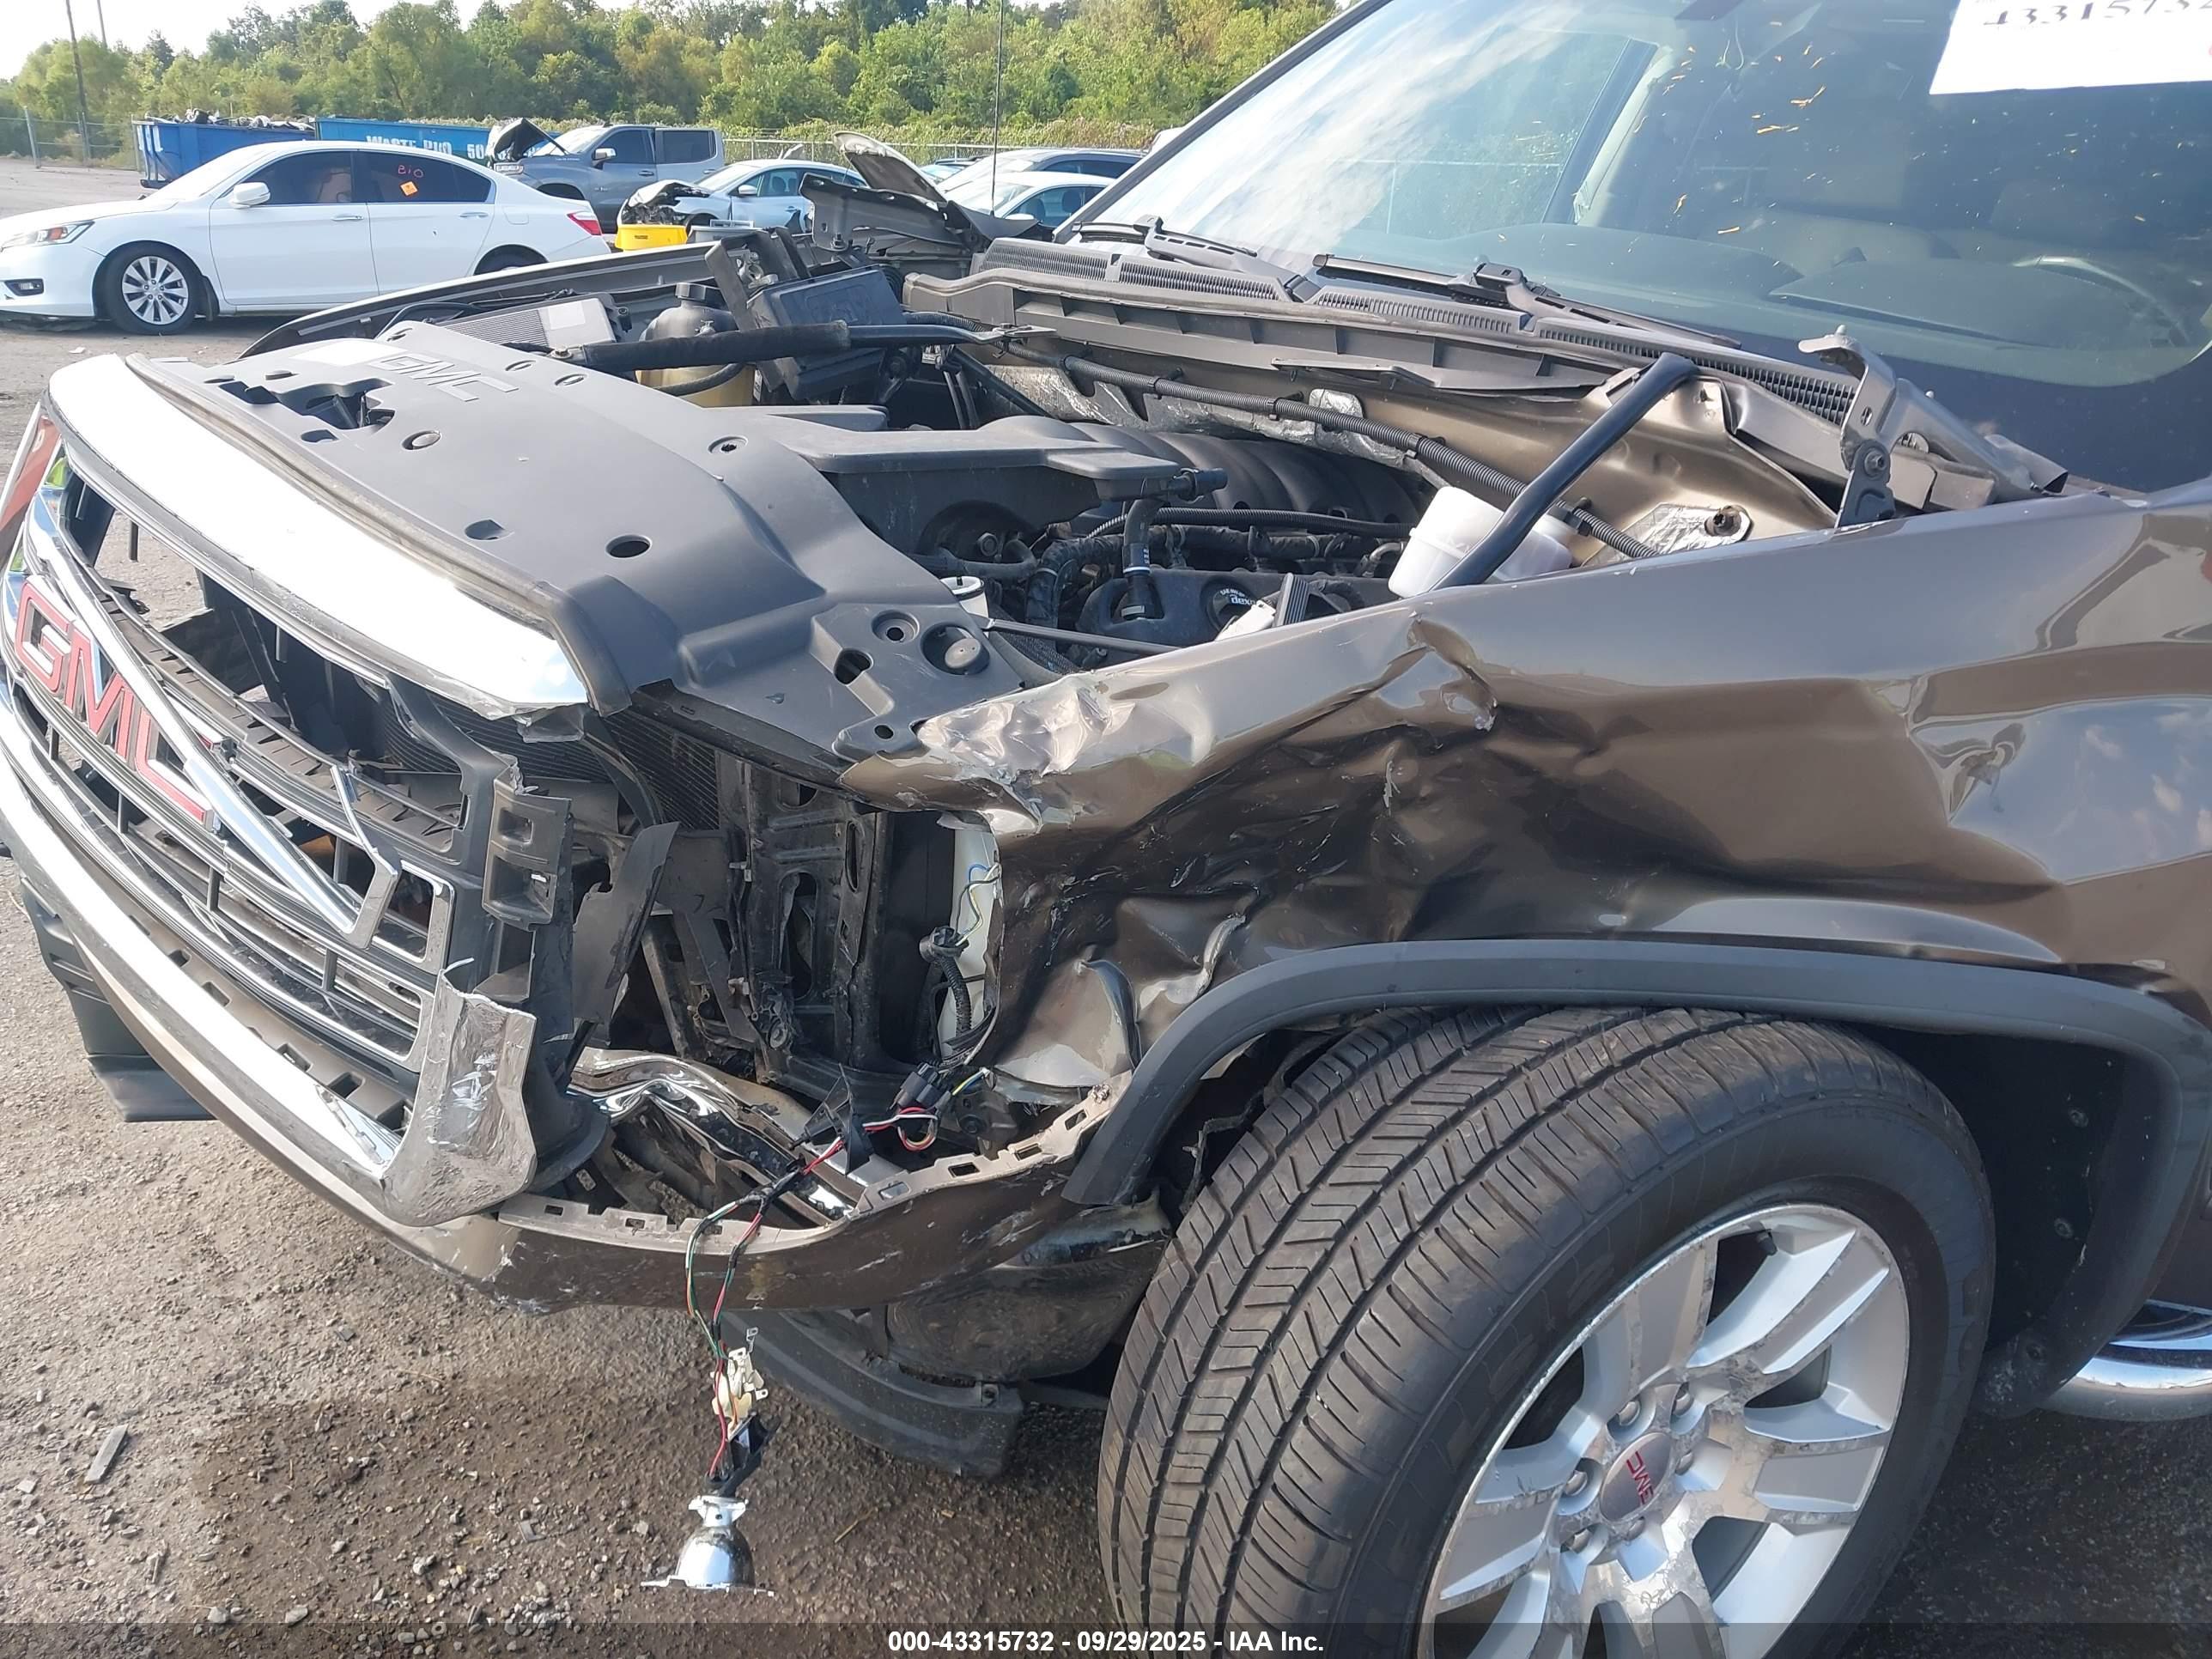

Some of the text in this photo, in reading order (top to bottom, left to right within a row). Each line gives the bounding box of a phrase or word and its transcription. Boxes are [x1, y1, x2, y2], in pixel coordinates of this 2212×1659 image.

[368, 354, 519, 402] GMC
[15, 580, 211, 823] GMC
[1625, 1449, 1655, 1506] GMC
